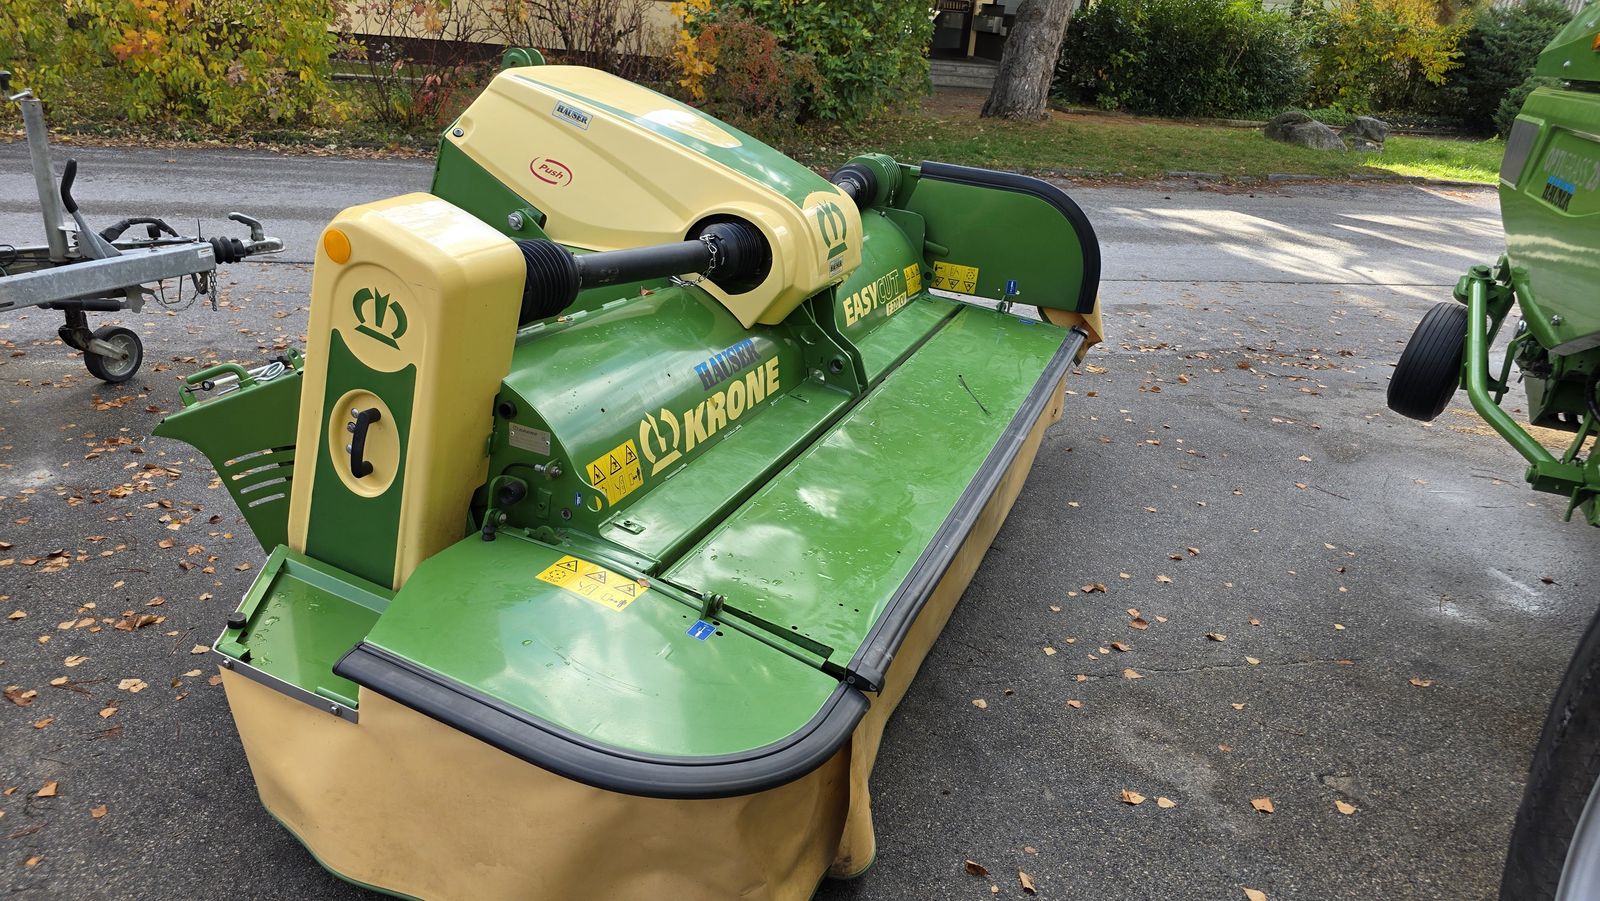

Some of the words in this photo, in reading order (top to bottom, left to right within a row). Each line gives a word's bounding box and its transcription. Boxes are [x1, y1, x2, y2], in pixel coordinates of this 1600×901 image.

[556, 105, 588, 124] HAUSER
[538, 163, 564, 180] Push
[693, 337, 762, 391] HAUSER
[684, 356, 780, 453] KRONE
